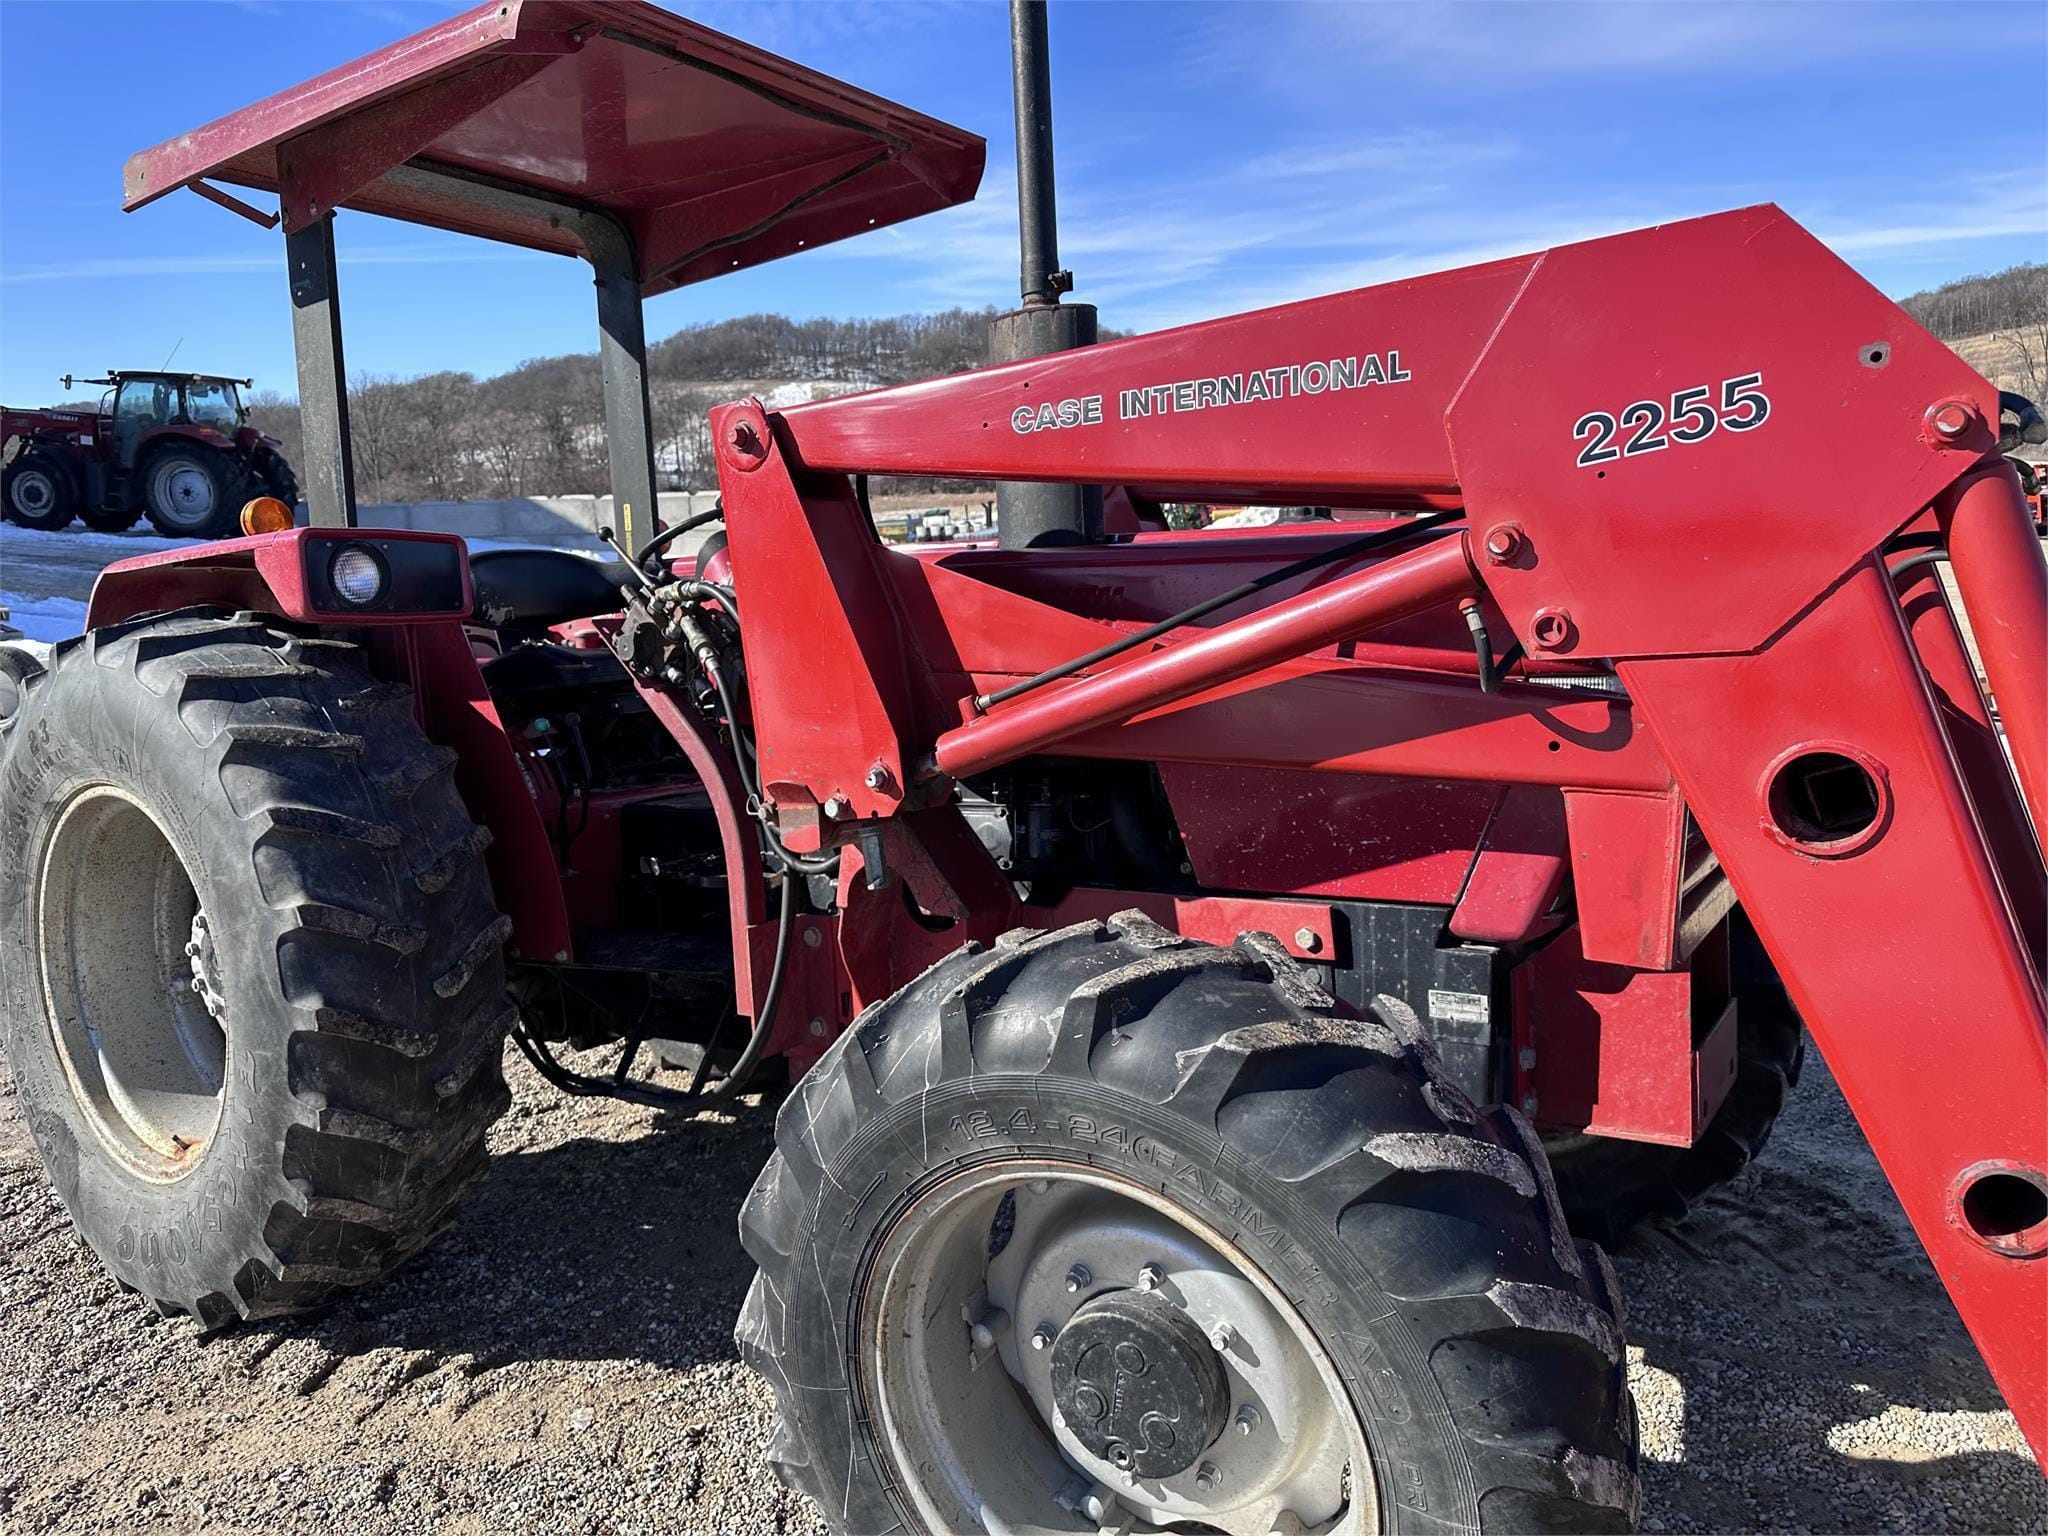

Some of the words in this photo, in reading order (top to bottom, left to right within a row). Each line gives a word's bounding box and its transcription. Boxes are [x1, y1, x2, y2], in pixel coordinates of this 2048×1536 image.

[1011, 396, 1102, 435] CASE
[1120, 350, 1412, 420] INTERNATIONAL
[1573, 371, 1771, 468] 2255
[1148, 1146, 1341, 1308] FARMER
